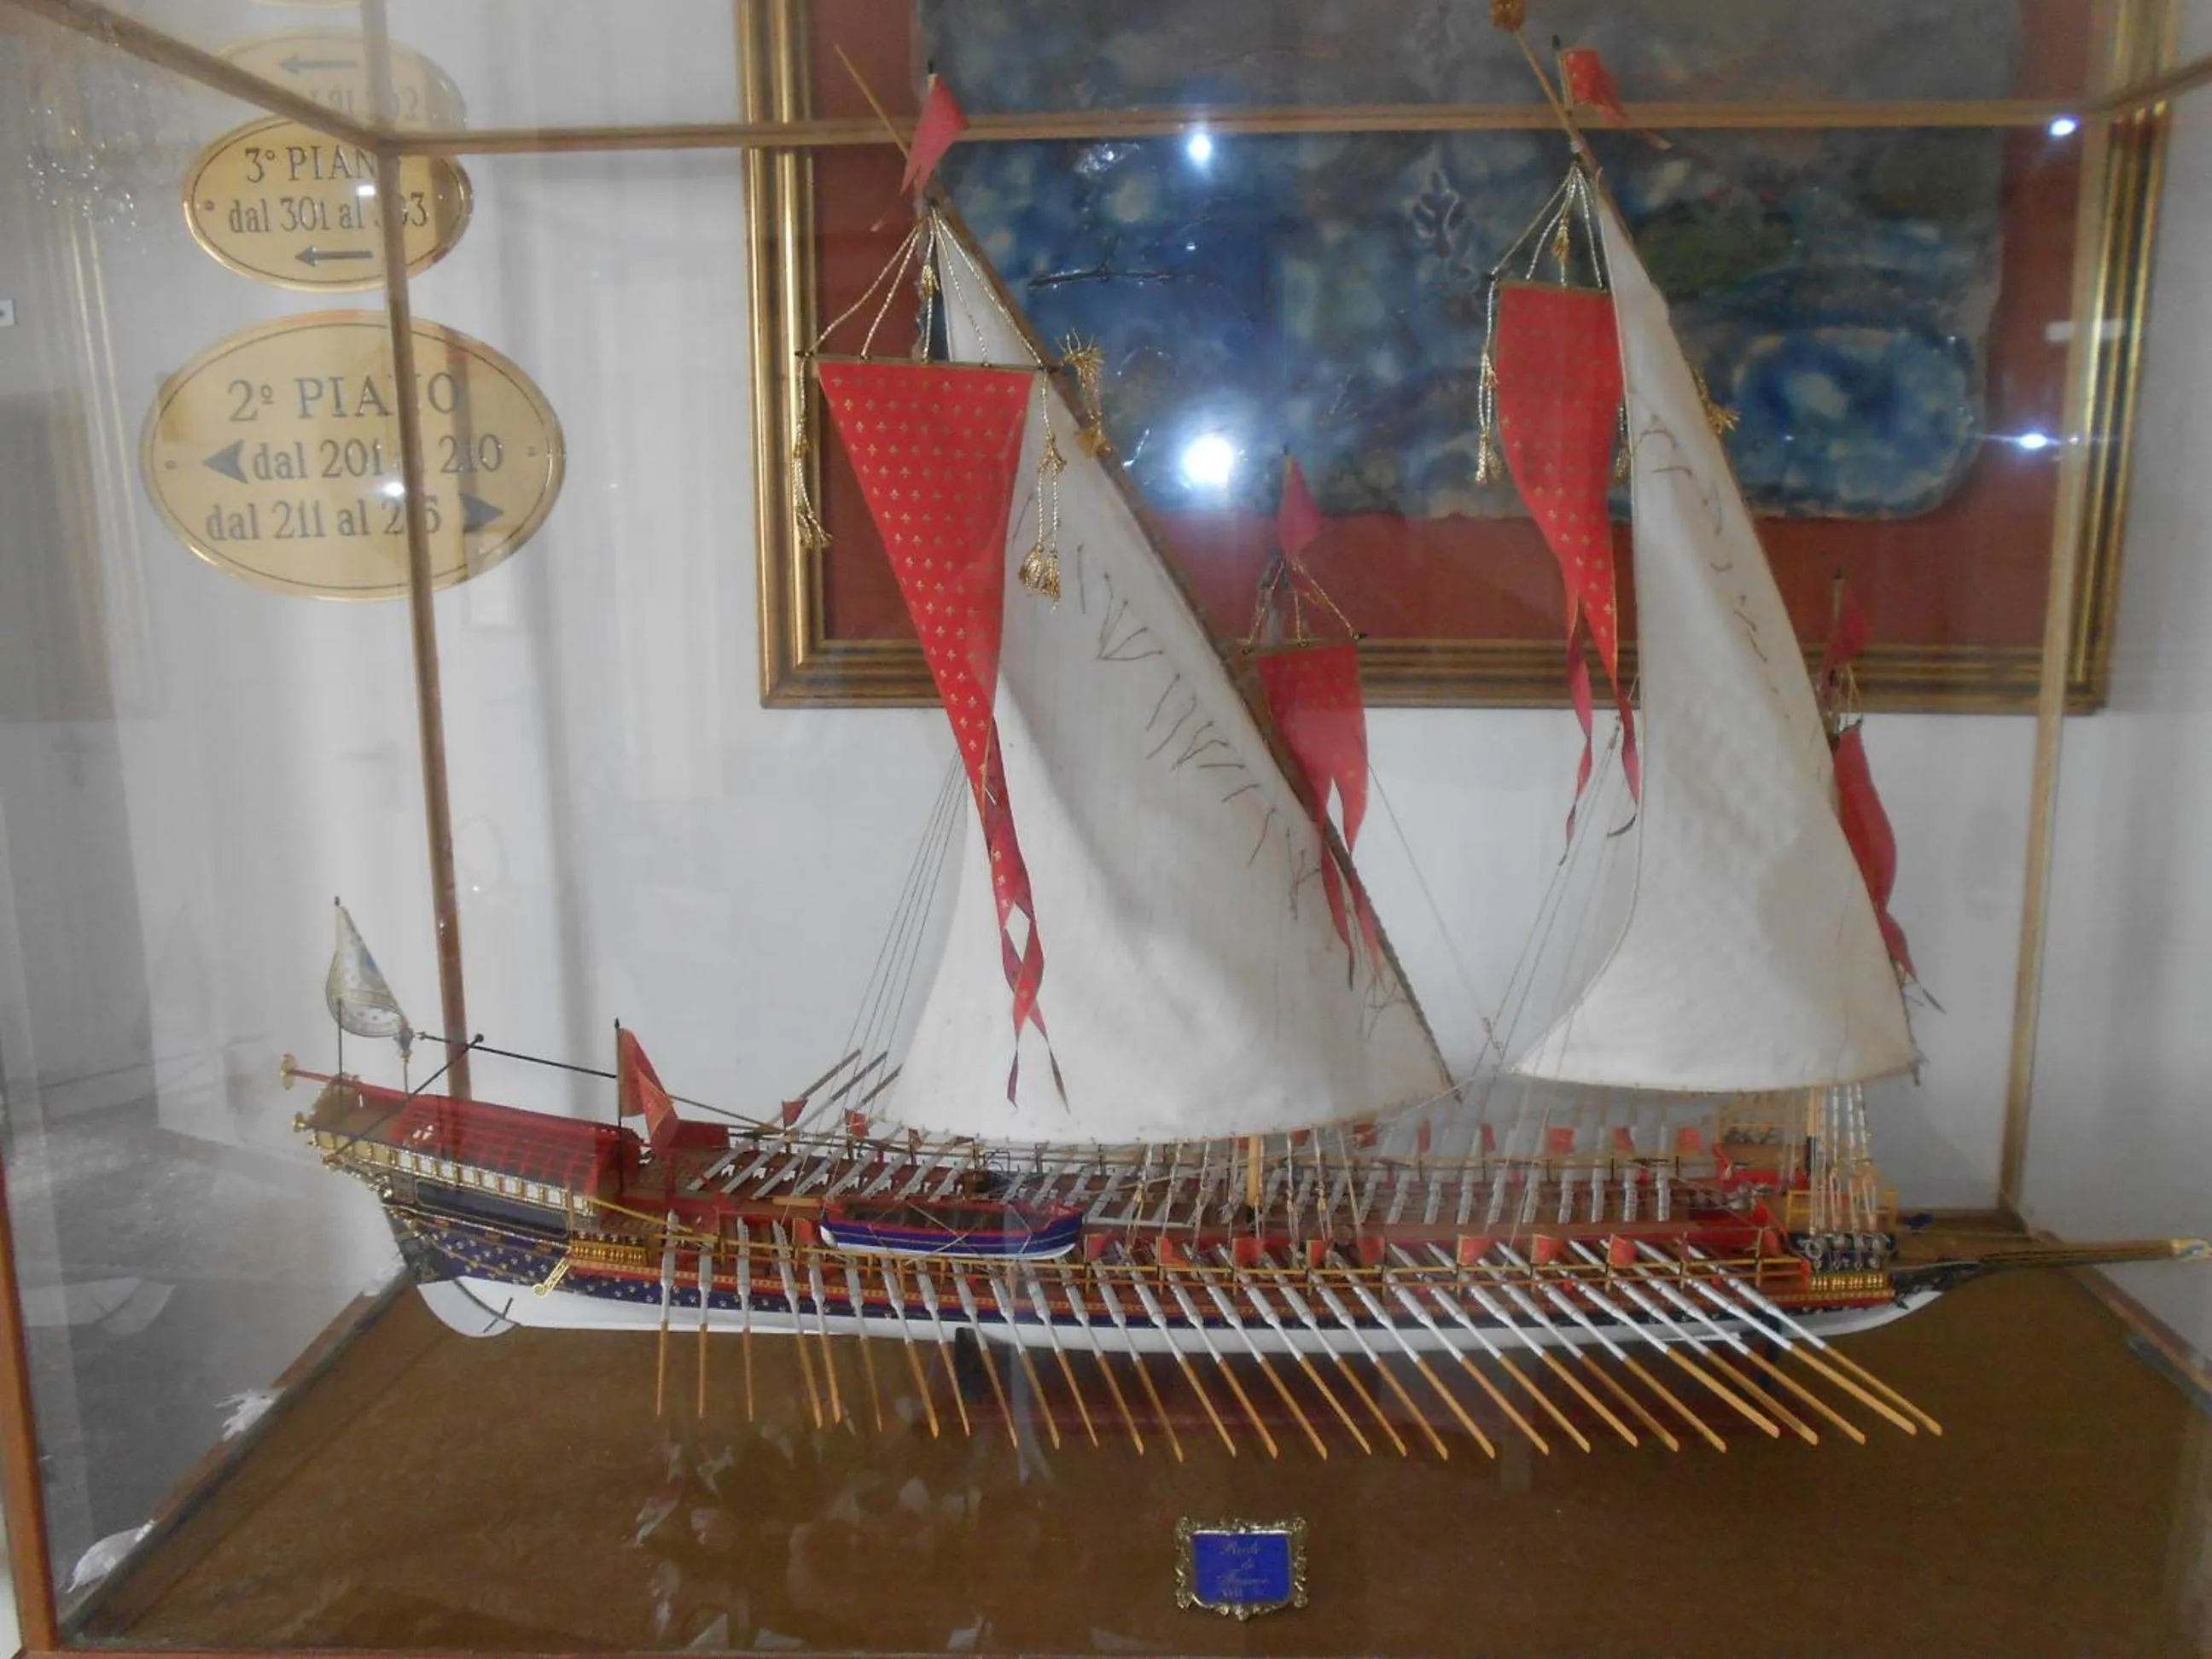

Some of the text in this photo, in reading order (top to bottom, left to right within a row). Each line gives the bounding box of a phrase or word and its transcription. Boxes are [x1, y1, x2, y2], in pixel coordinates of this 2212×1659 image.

[286, 143, 381, 182] PIAN
[228, 198, 271, 234] dal
[279, 195, 331, 232] 301
[338, 194, 366, 230] al
[294, 371, 463, 420] PIAO
[252, 440, 309, 481] dal
[319, 437, 384, 480] 201
[205, 493, 442, 542] dal 211 al 25
